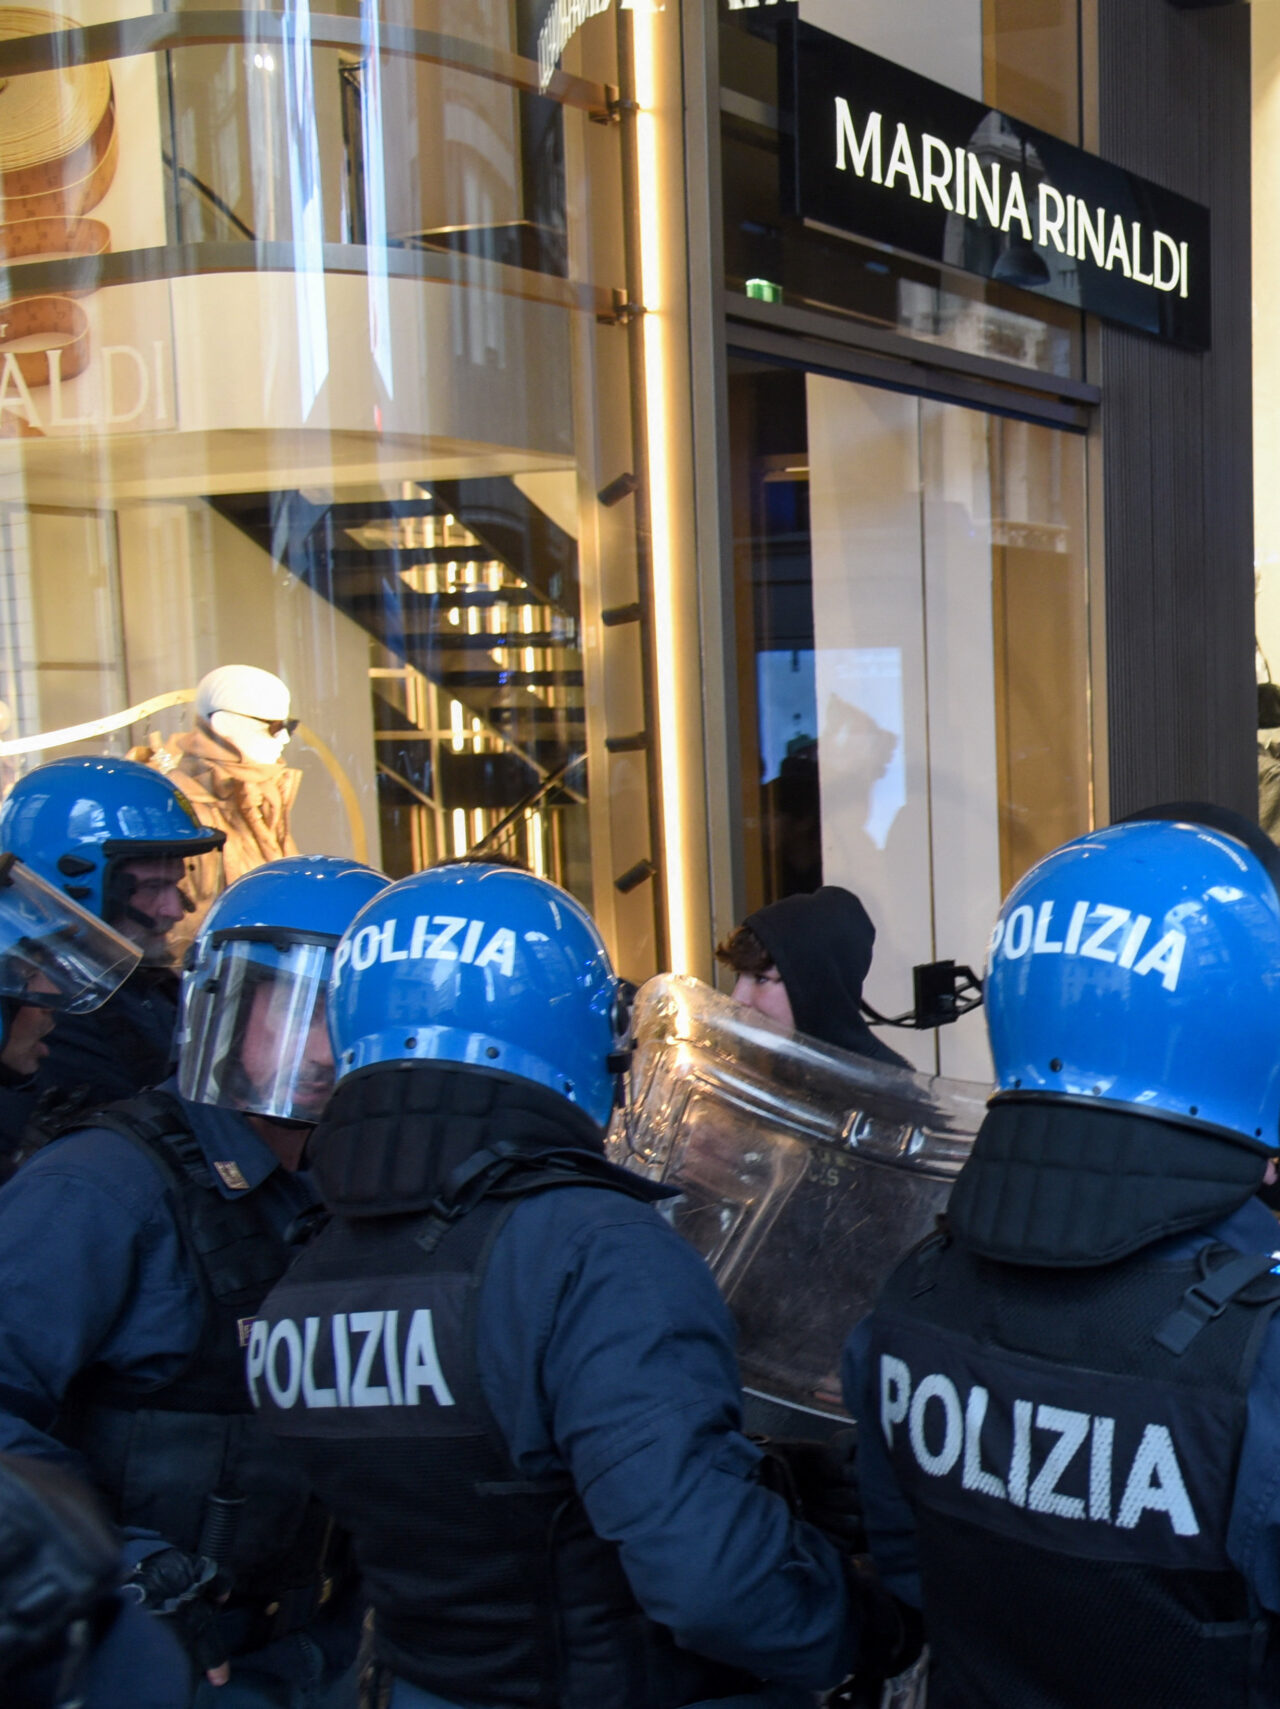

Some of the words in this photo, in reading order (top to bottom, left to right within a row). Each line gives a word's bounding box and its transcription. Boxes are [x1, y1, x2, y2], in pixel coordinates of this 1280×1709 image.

[834, 96, 1033, 241] MARINA
[1037, 182, 1189, 298] RINALDI
[330, 915, 516, 990] POLIZIA
[983, 900, 1187, 993] POLIZIA
[246, 1309, 456, 1410] POLIZIA
[880, 1353, 1201, 1537] POLIZIA
